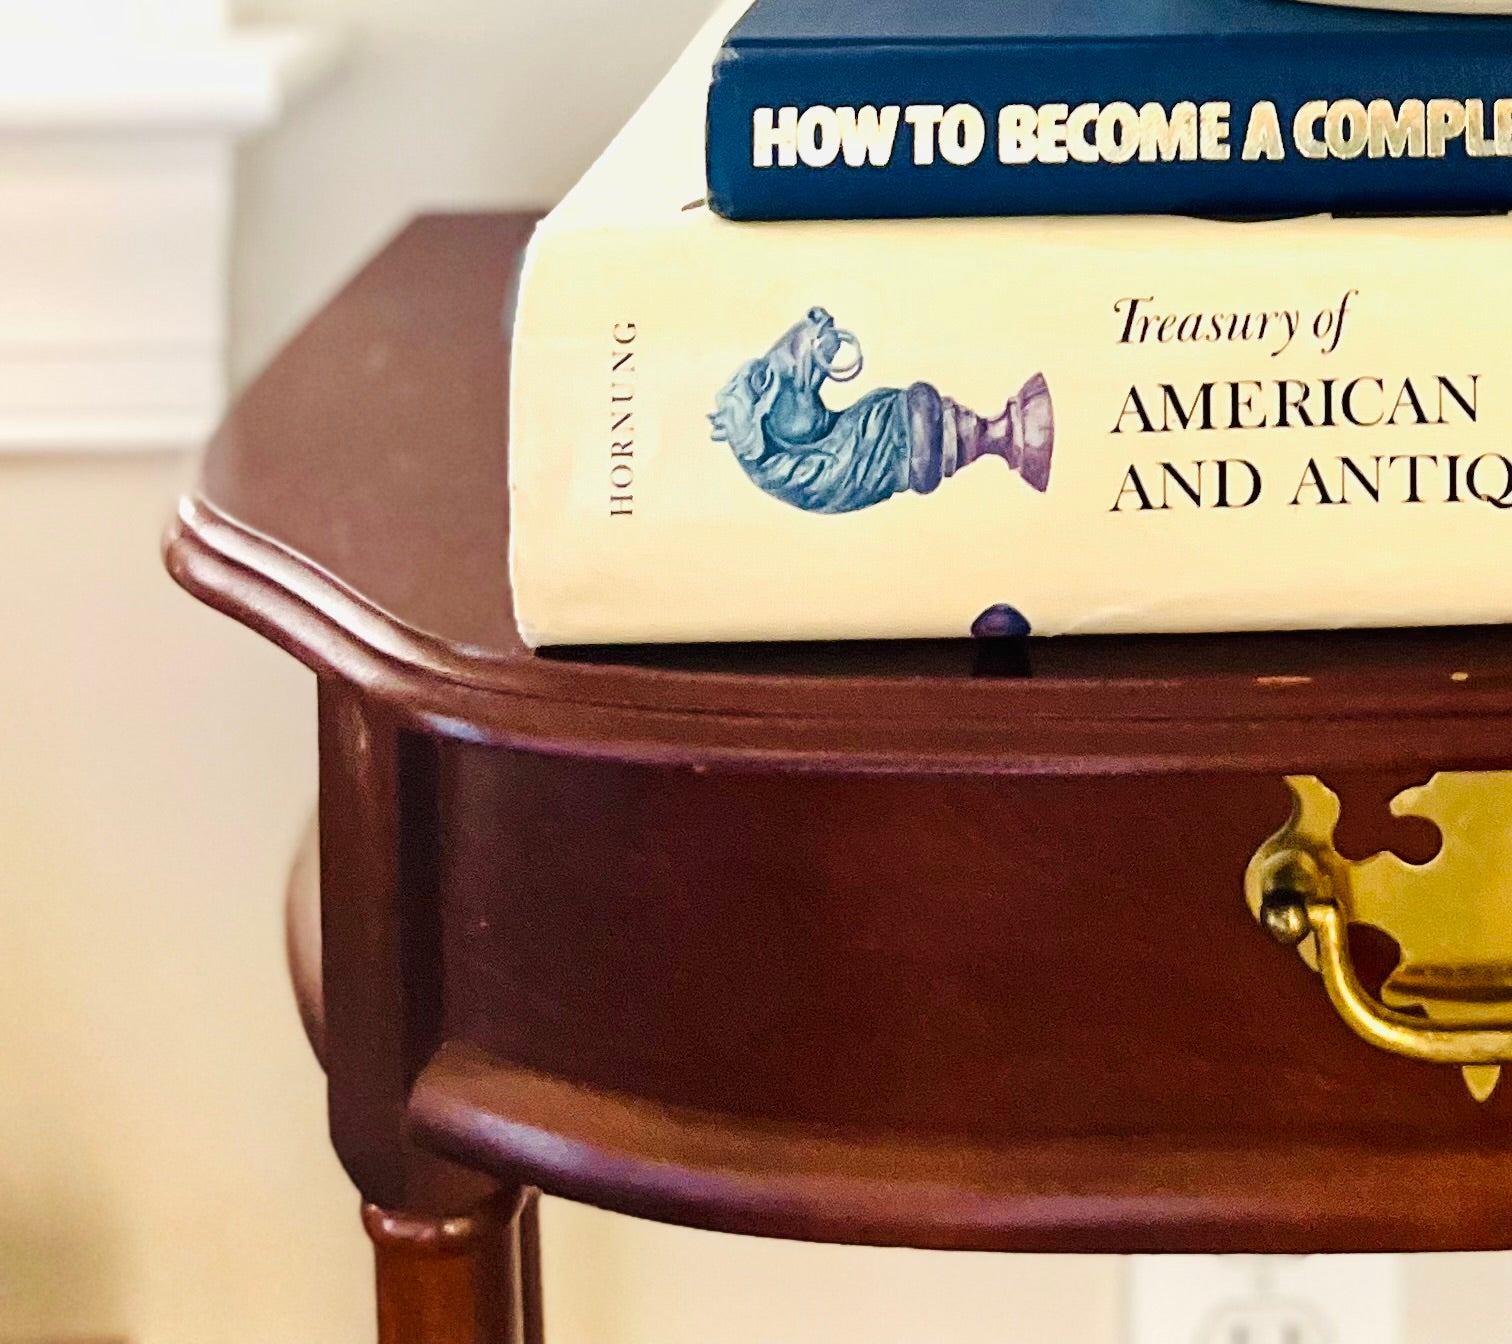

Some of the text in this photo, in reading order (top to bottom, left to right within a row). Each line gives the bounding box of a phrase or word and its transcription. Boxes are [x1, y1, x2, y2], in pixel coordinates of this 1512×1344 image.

[752, 105, 899, 167] HOW
[905, 102, 986, 166] TO
[998, 100, 1231, 164] BECOME
[1241, 100, 1284, 160] A
[1113, 289, 1359, 356] Treasury of
[610, 322, 637, 517] HORNUNG
[1109, 374, 1481, 433] AMERICAN
[1109, 458, 1262, 512] AND
